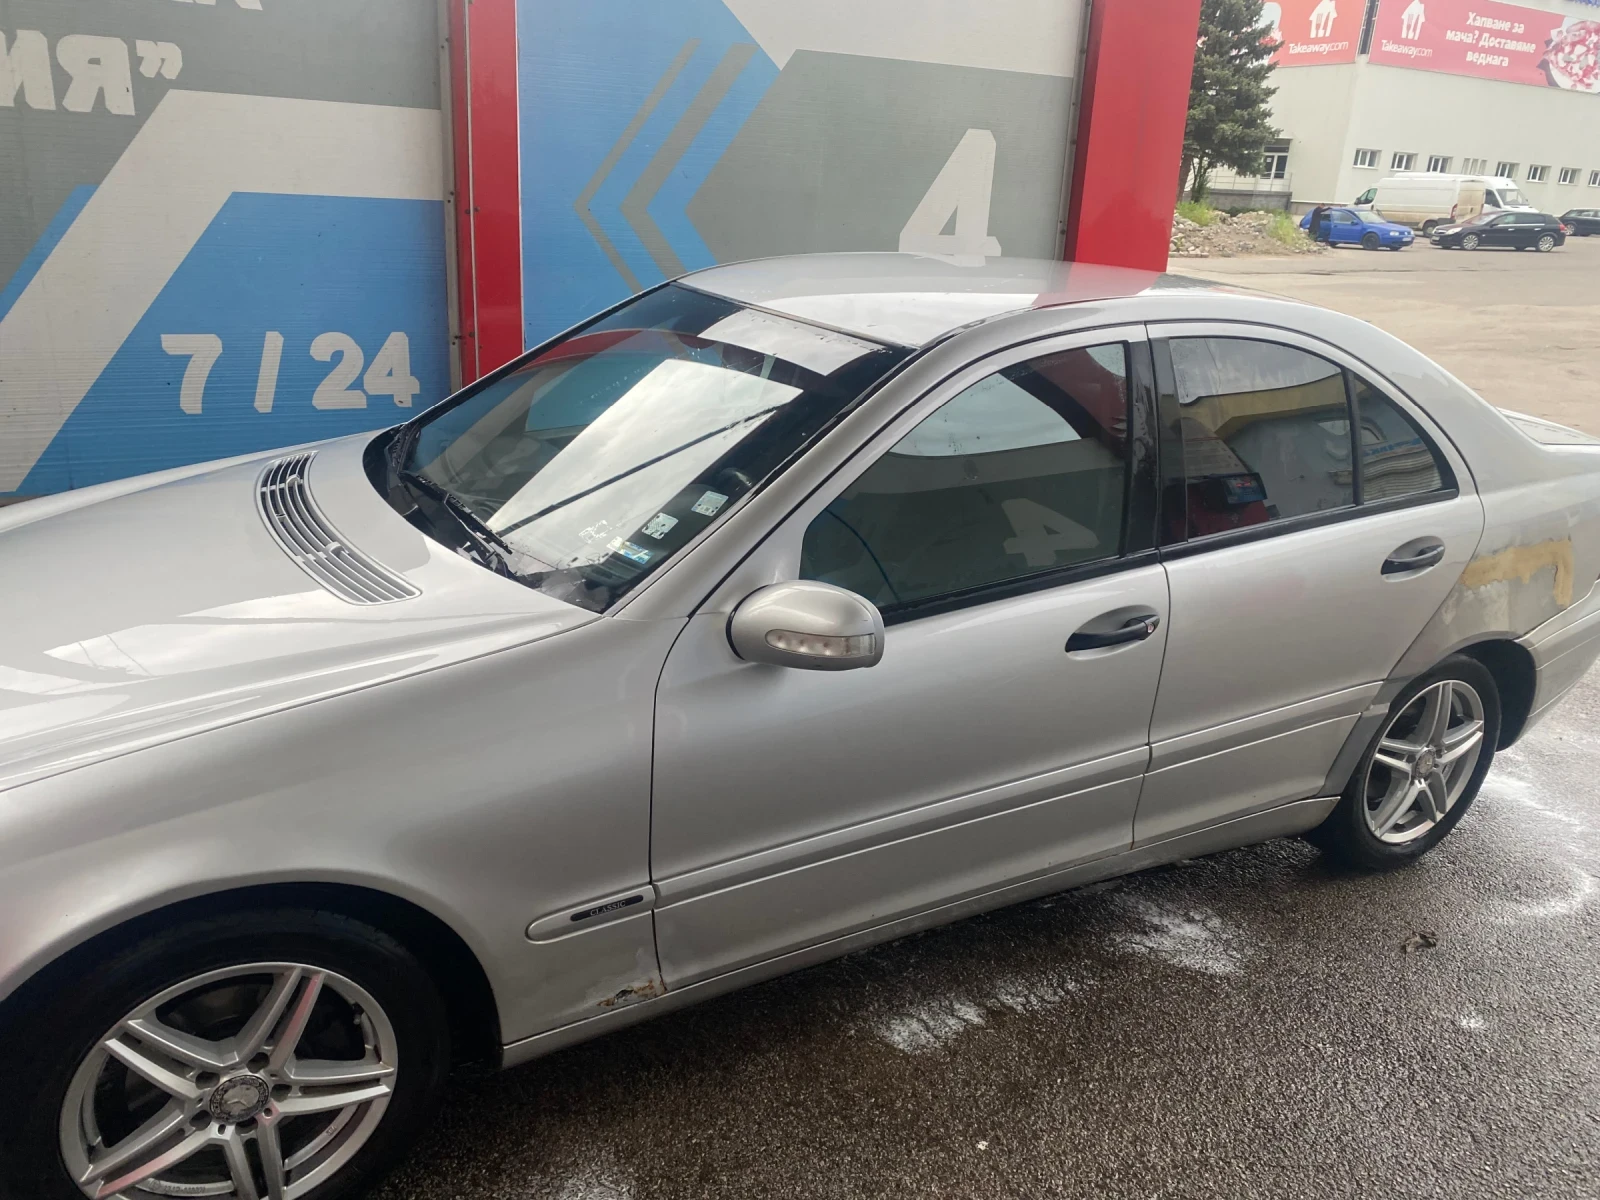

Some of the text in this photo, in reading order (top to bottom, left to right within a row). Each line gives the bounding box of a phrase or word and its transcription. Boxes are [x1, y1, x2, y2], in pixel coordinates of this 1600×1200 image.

[1466, 11, 1525, 34] Хапване за
[1446, 29, 1537, 53] мача? Доставяме
[1466, 51, 1509, 67] веднага
[899, 128, 1002, 259] 4
[160, 334, 223, 415] 7
[309, 331, 420, 410] 24
[590, 900, 626, 917] CLASSIC
